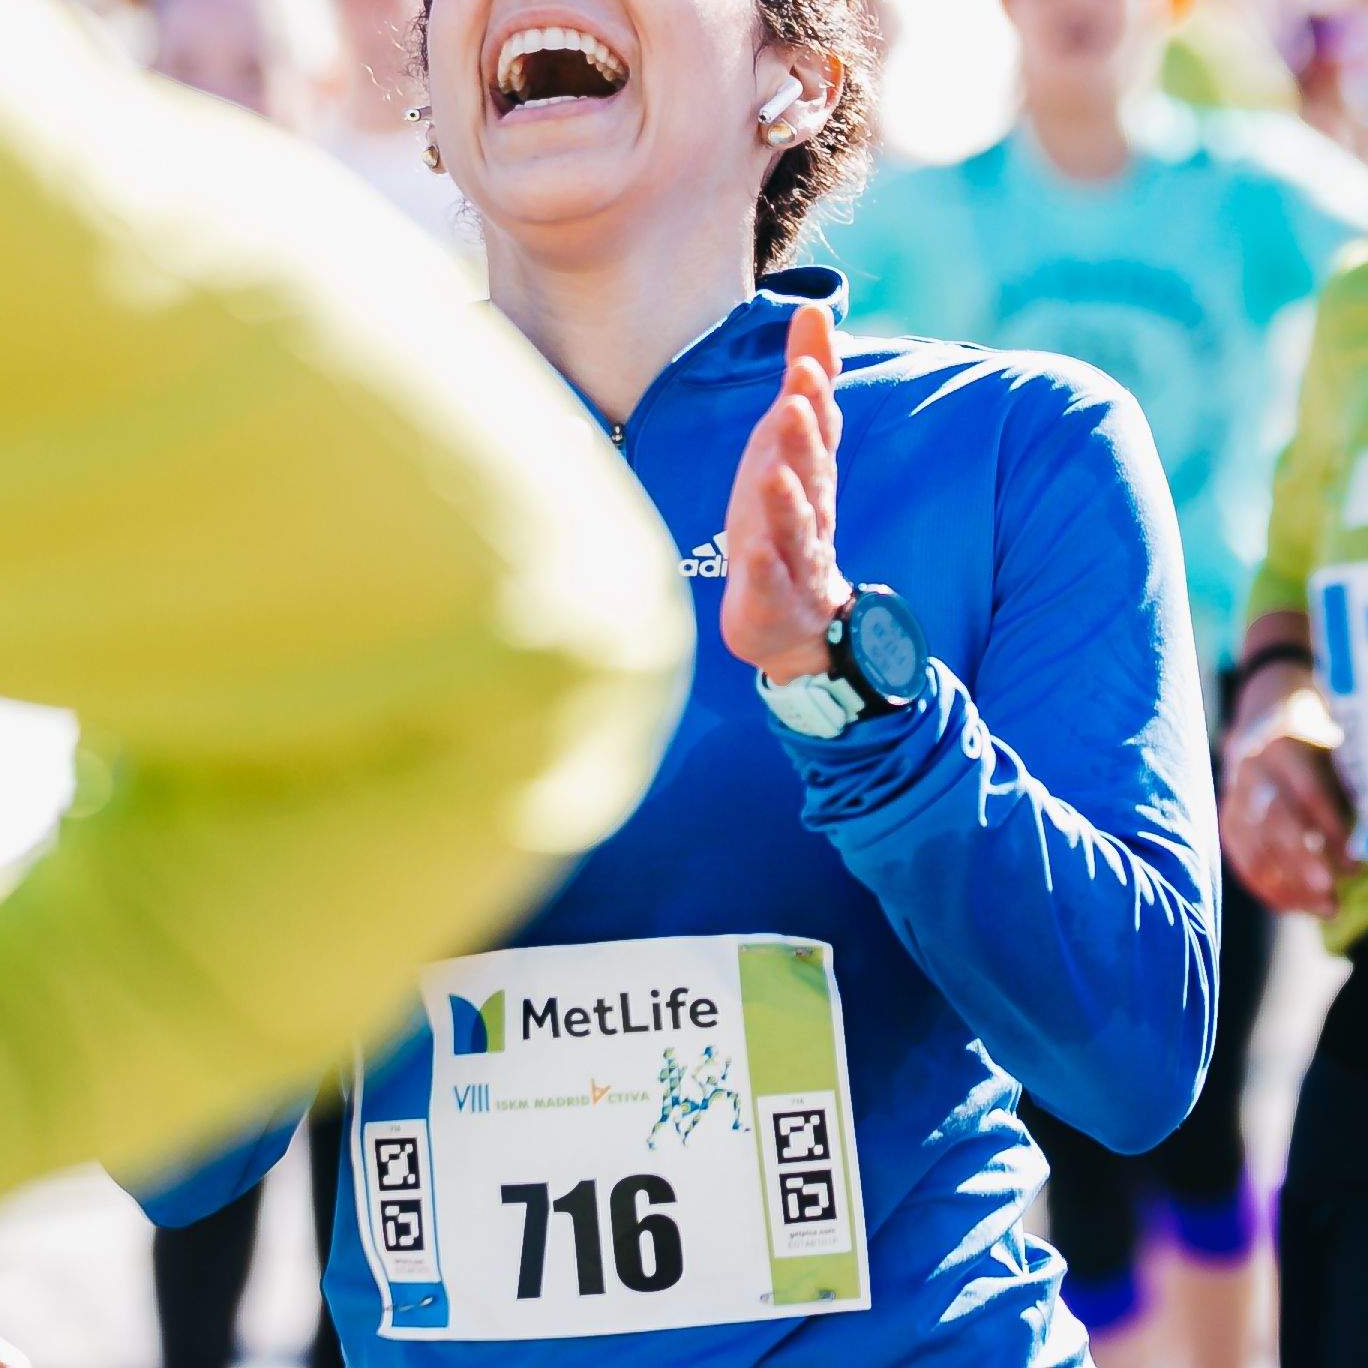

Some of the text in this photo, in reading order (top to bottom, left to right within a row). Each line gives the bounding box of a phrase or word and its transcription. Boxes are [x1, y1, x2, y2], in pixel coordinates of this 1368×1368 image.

[521, 986, 719, 1040] MetLife
[453, 1084, 490, 1113] VIII
[500, 1173, 684, 1300] 716
